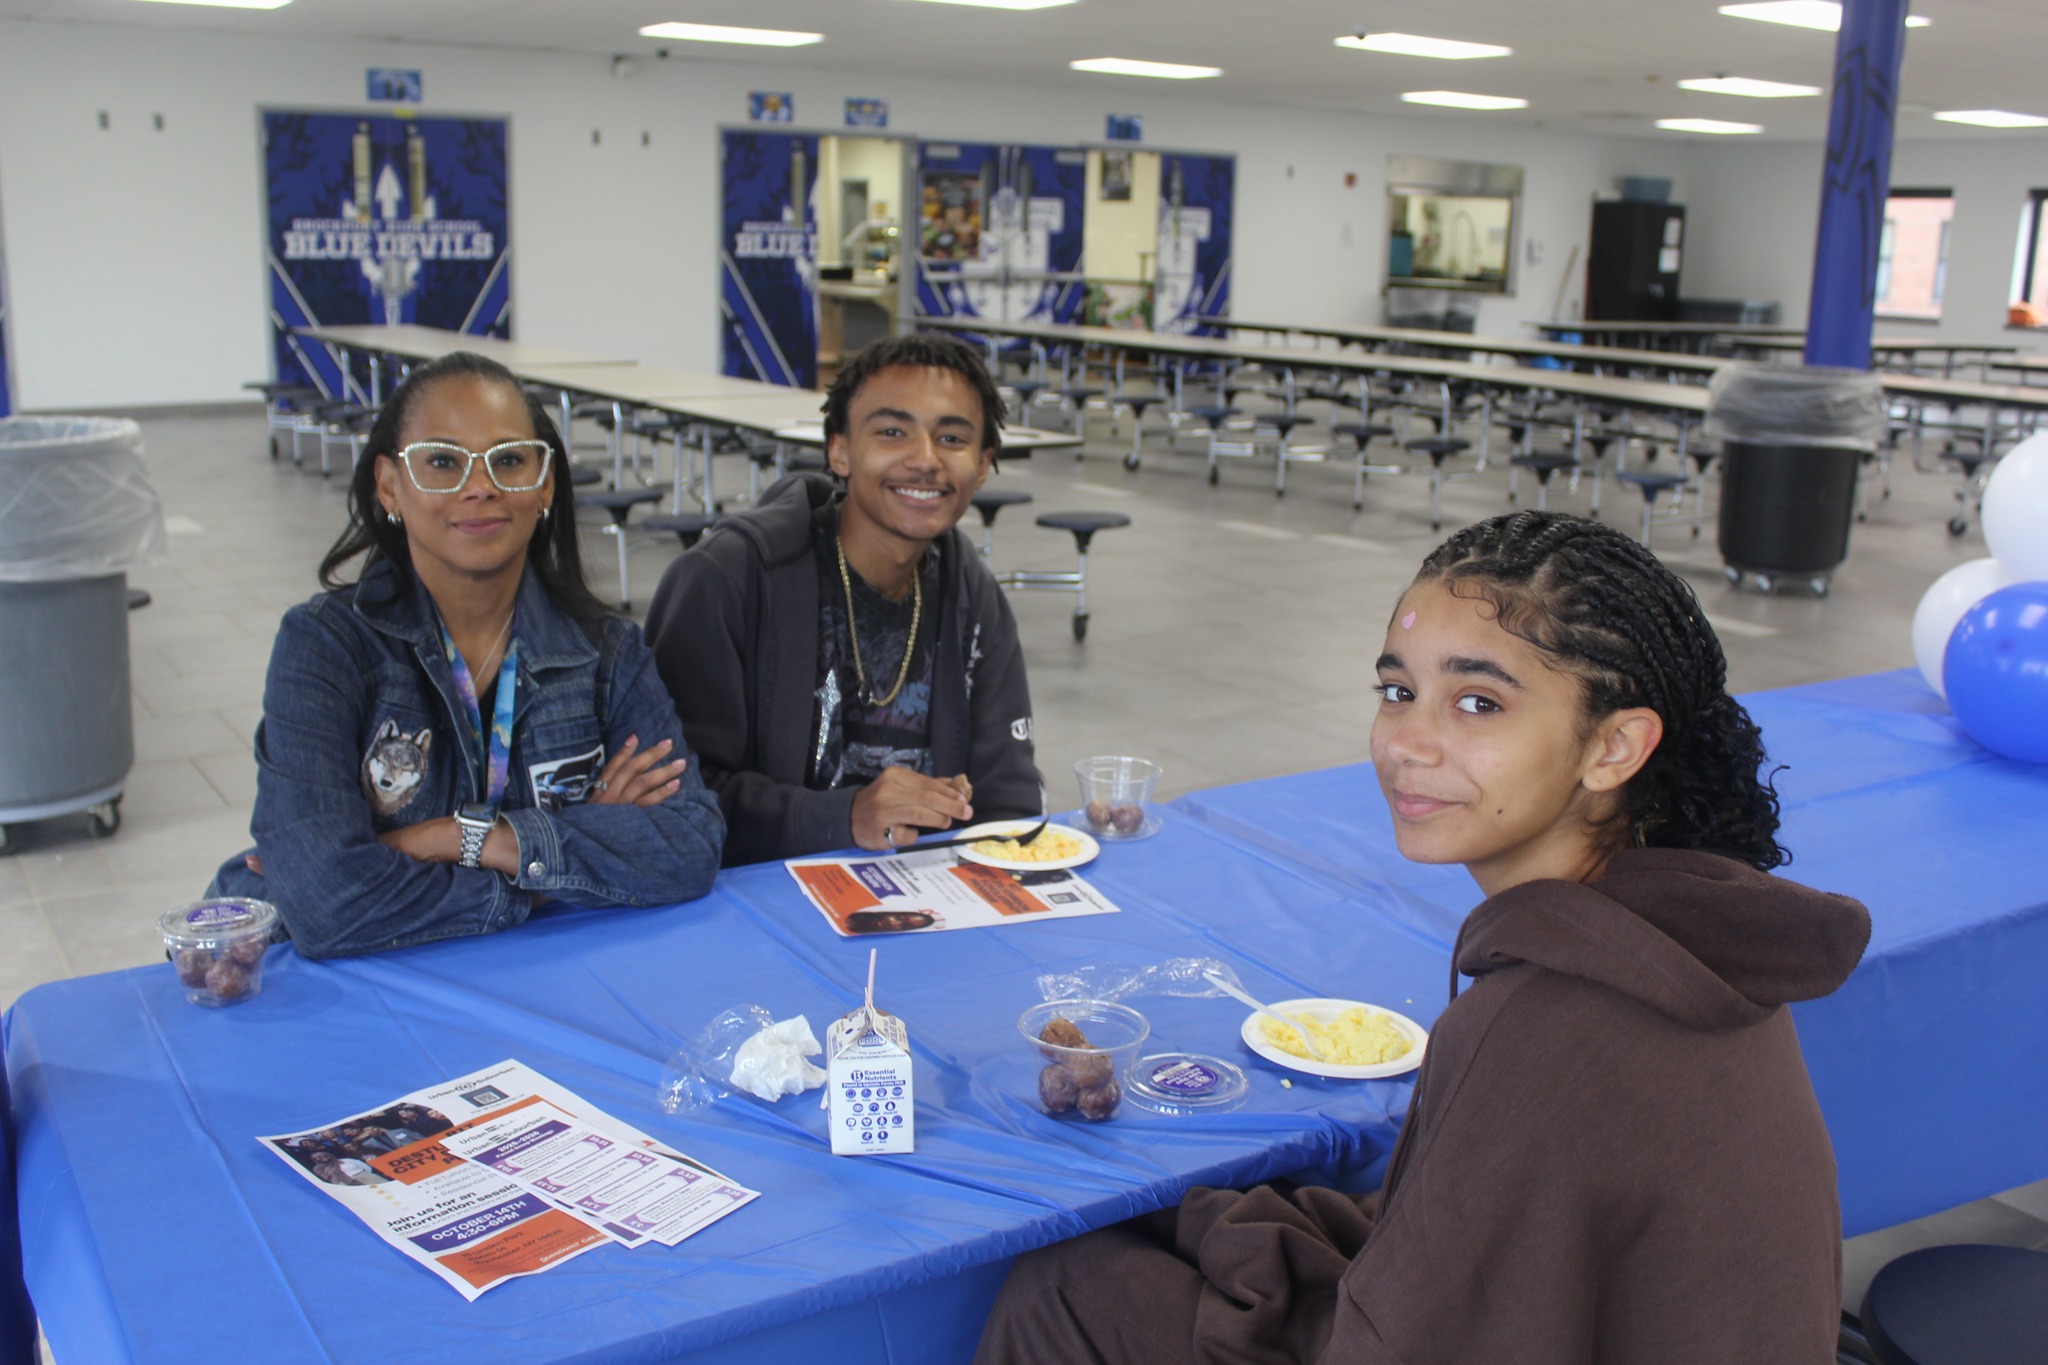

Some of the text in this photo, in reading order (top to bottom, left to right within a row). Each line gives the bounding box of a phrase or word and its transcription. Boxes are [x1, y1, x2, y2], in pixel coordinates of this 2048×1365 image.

[284, 231, 494, 260] BLUE DEVILS
[735, 233, 804, 258] BLUE
[458, 1130, 488, 1145] Urban
[463, 1141, 493, 1156] Urban
[503, 1116, 547, 1137] Suburban
[393, 1155, 436, 1174] CITY
[387, 1191, 477, 1227] Join us for an
[392, 1183, 518, 1232] information sessio
[431, 1200, 527, 1241] OCTOBER 14TH
[457, 1211, 520, 1241] 4:30-6PM
